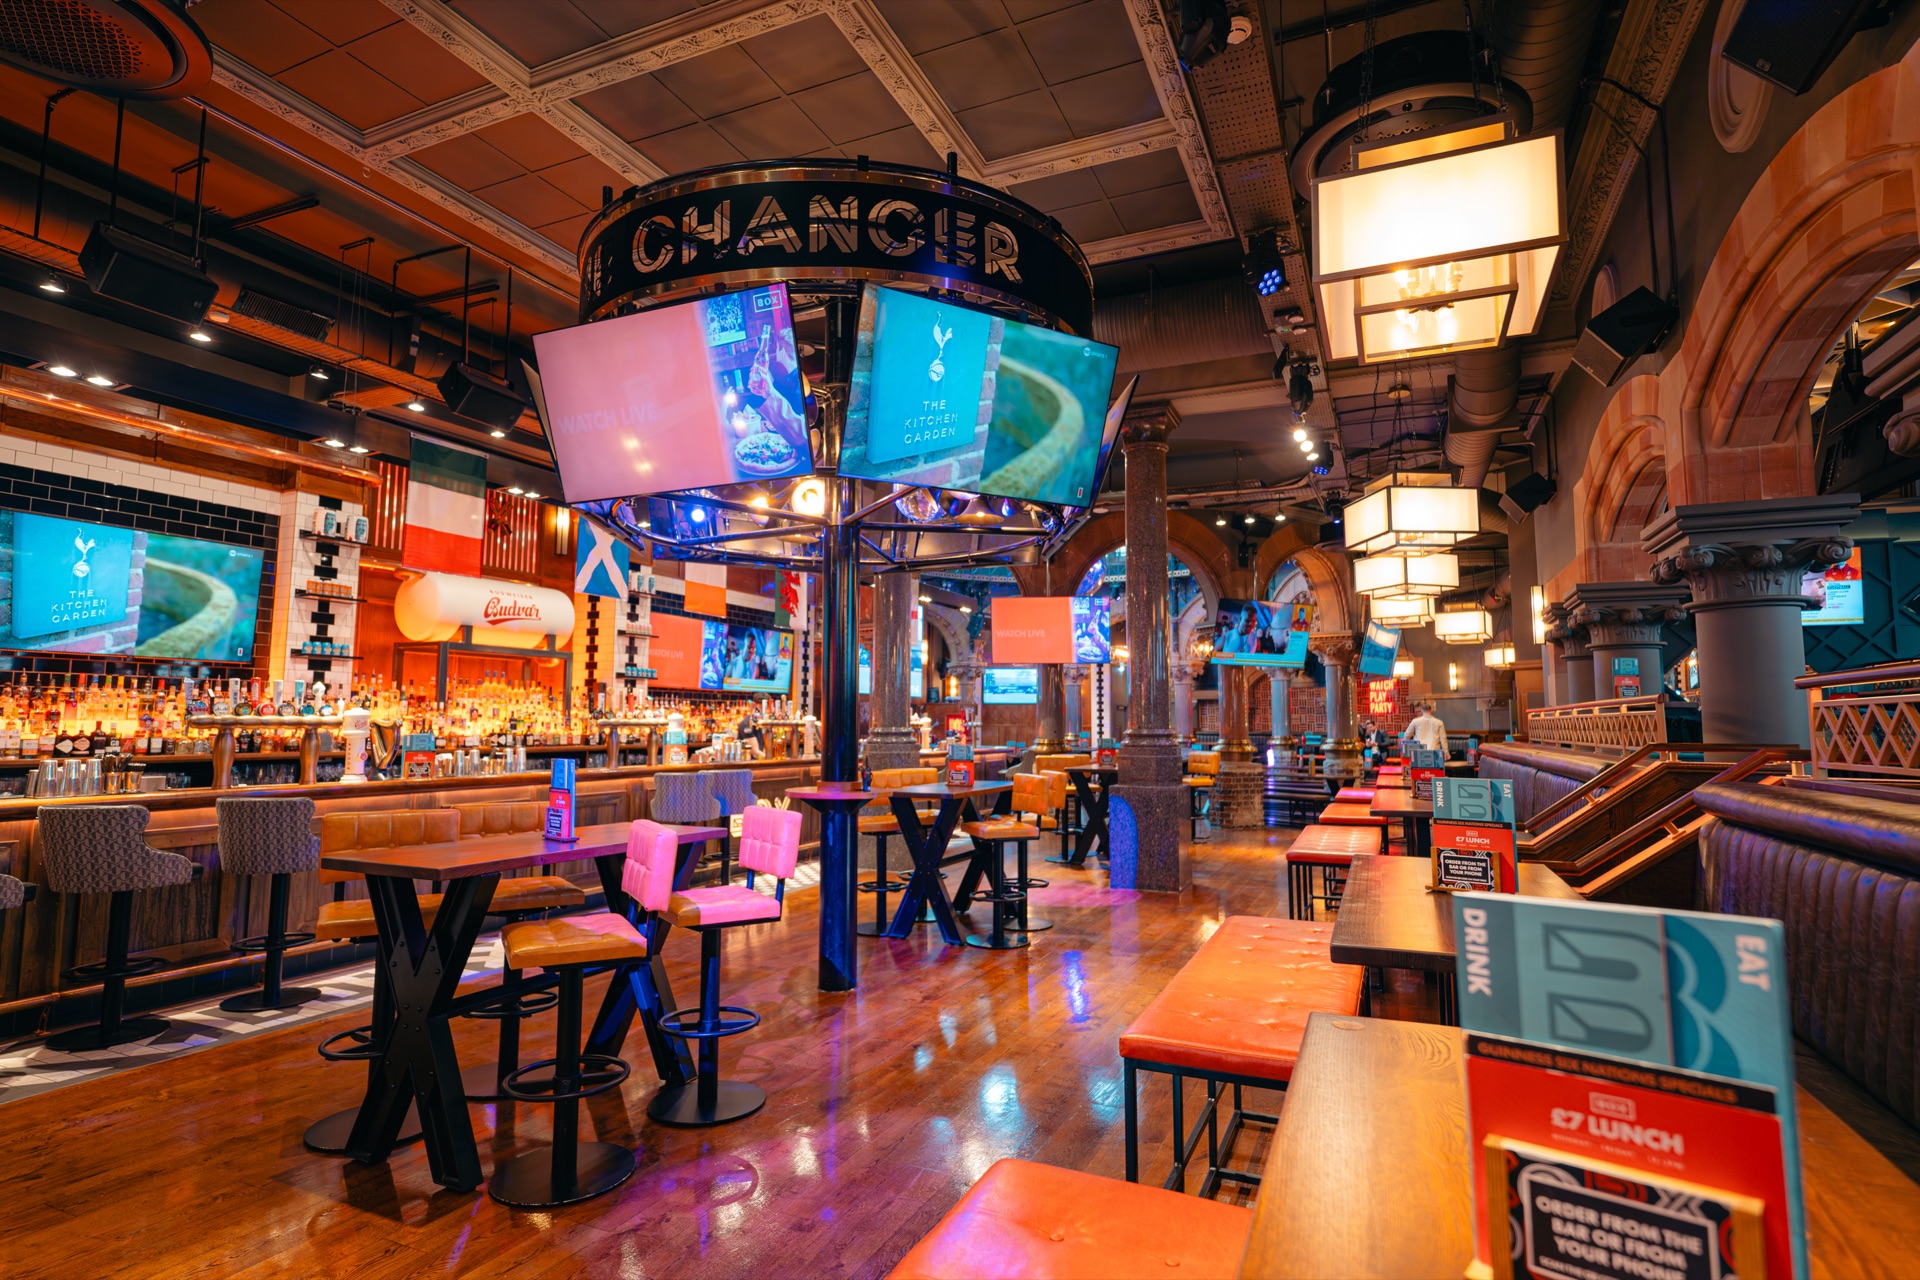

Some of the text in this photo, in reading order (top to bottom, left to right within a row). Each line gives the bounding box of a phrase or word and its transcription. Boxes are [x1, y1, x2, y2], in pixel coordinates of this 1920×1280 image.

[632, 195, 1023, 284] CHANGER
[757, 296, 778, 307] BOX
[923, 400, 946, 411] THE
[557, 401, 657, 435] WATCH LIVE
[904, 413, 959, 429] KITCHEN
[904, 427, 956, 444] GARDEN
[69, 589, 94, 599] THE
[51, 599, 107, 612] KITCHEN
[483, 597, 541, 624] Budvar
[52, 609, 106, 623] GARDEN
[995, 629, 1046, 638] WATCH LIVE
[1370, 691, 1387, 702] PLAY
[1370, 702, 1393, 713] PARTY
[1435, 781, 1444, 807] DRINK
[1503, 783, 1511, 798] EAT
[1465, 837, 1490, 845] LUNCH
[1463, 907, 1493, 997] DRINK
[1735, 934, 1771, 992] EAT
[1477, 1040, 1738, 1105] GUINNESS SIX NATIONS SPECIALS
[1587, 1114, 1685, 1157] LUNCH
[1535, 1195, 1703, 1256] ORDER FROM THE
[1551, 1216, 1688, 1271] BAR OR FROM
[1553, 1235, 1612, 1268] YOUR
